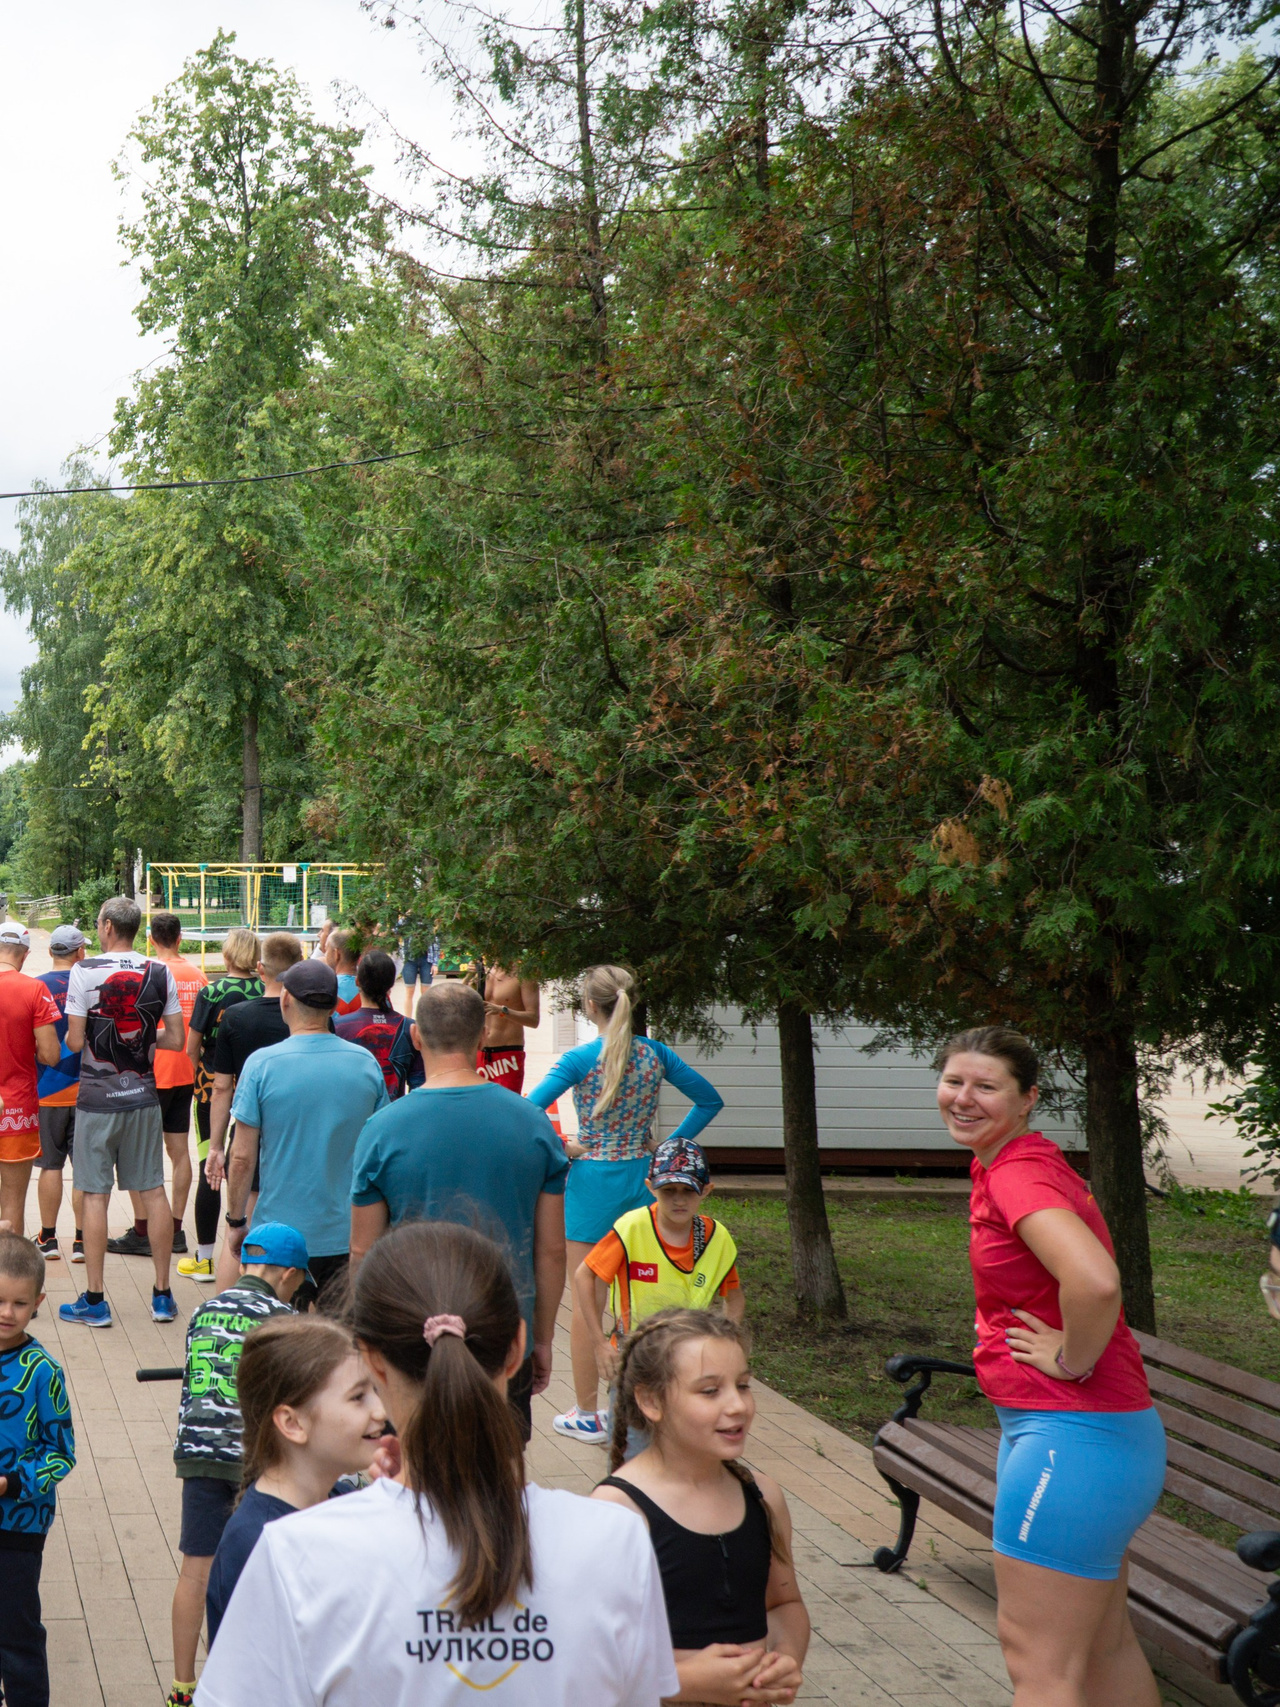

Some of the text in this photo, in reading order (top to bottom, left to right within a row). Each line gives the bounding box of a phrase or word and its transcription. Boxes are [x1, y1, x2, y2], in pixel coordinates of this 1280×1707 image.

[476, 1055, 519, 1080] ONIN
[106, 1087, 145, 1098] NATASHINSKY
[1018, 1471, 1051, 1543] SWOOSH BY NIKE
[513, 1607, 548, 1633] de
[405, 1637, 554, 1664] ЧУЛКОВО
